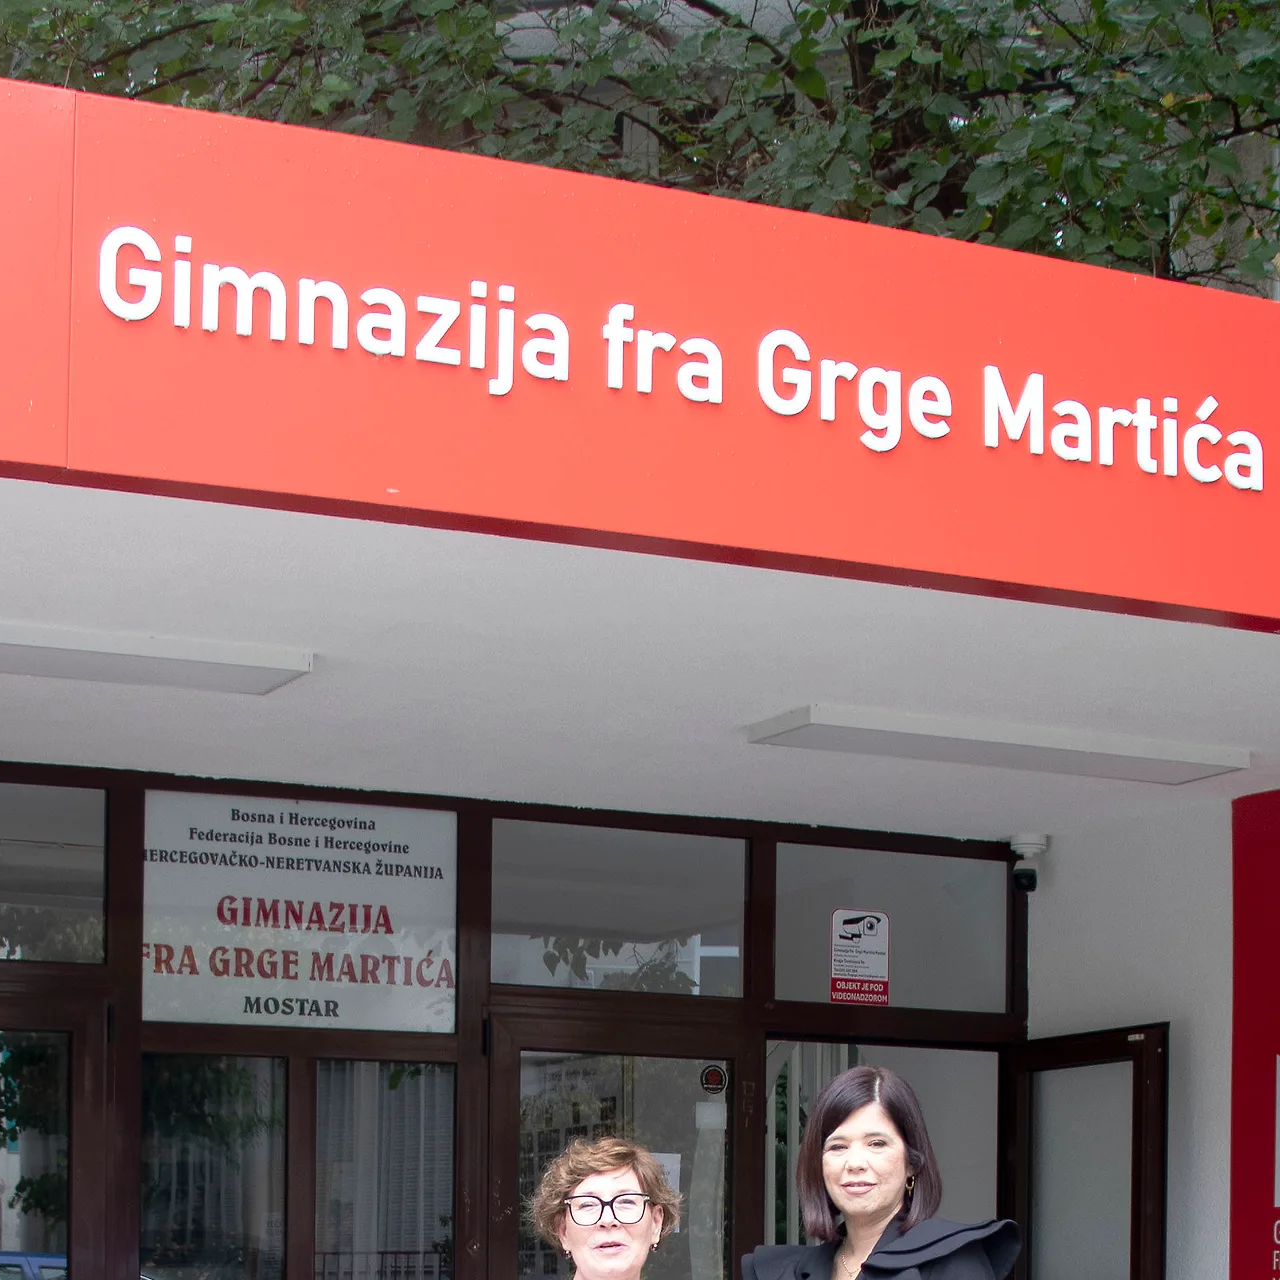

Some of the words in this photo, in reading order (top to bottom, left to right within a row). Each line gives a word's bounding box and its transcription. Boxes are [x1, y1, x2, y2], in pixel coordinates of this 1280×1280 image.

[98, 225, 570, 397] Gimnazija
[601, 303, 723, 405] fra
[757, 328, 953, 453] Grge
[983, 365, 1265, 493] Martića
[230, 808, 275, 825] Bosna
[279, 811, 284, 825] i
[288, 812, 377, 831] Hercegovina
[189, 827, 264, 847] Federacija
[267, 832, 312, 848] Bosne
[314, 835, 320, 849] i
[323, 836, 411, 855] Hercegovine
[375, 862, 445, 881] ŽUPANIJA
[216, 895, 395, 936] GIMNAZIJA
[208, 946, 300, 981] GRGE
[308, 948, 457, 989] MARTIĆA
[831, 991, 888, 1002] VIDEONADZOROM
[836, 981, 861, 990] OBJEKT
[861, 983, 870, 991] JE
[870, 983, 884, 992] POD
[243, 996, 340, 1018] MOSTAR
